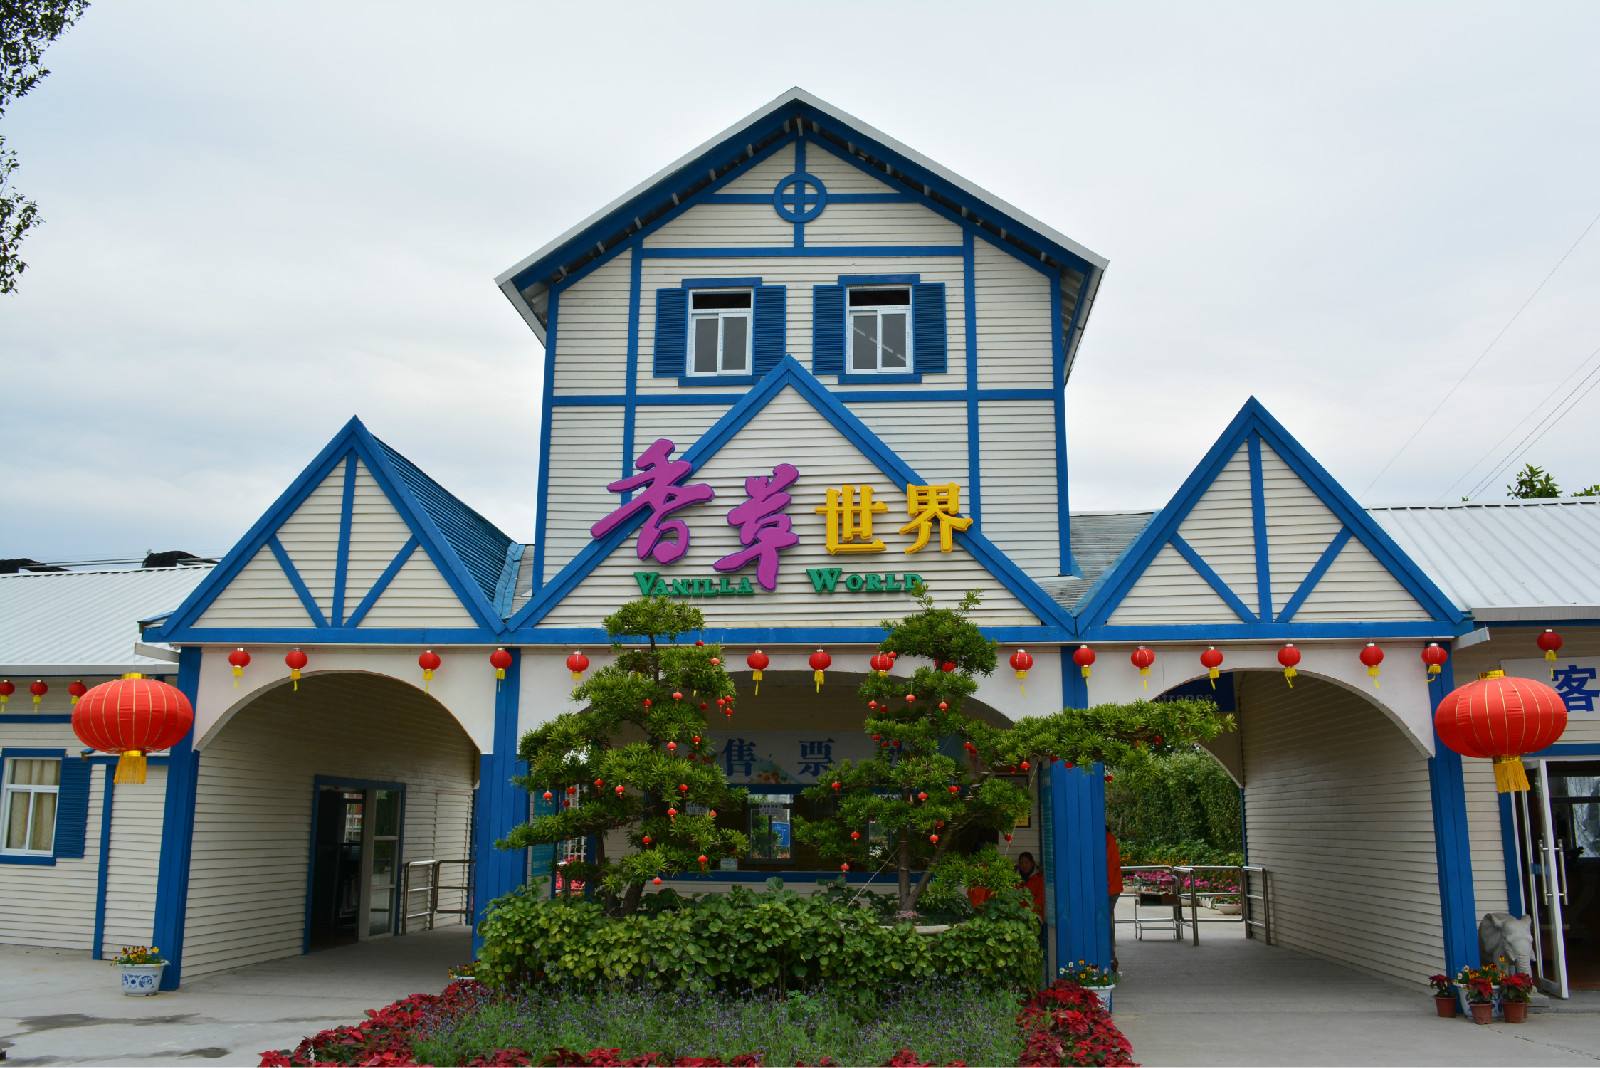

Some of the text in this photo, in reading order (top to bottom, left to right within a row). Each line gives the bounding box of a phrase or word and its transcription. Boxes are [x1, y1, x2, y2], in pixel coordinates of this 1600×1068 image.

[591, 438, 973, 591] 香草世界
[633, 568, 923, 597] VANILLA WORLD
[1552, 665, 1600, 712] 客
[721, 737, 911, 777] 售票
